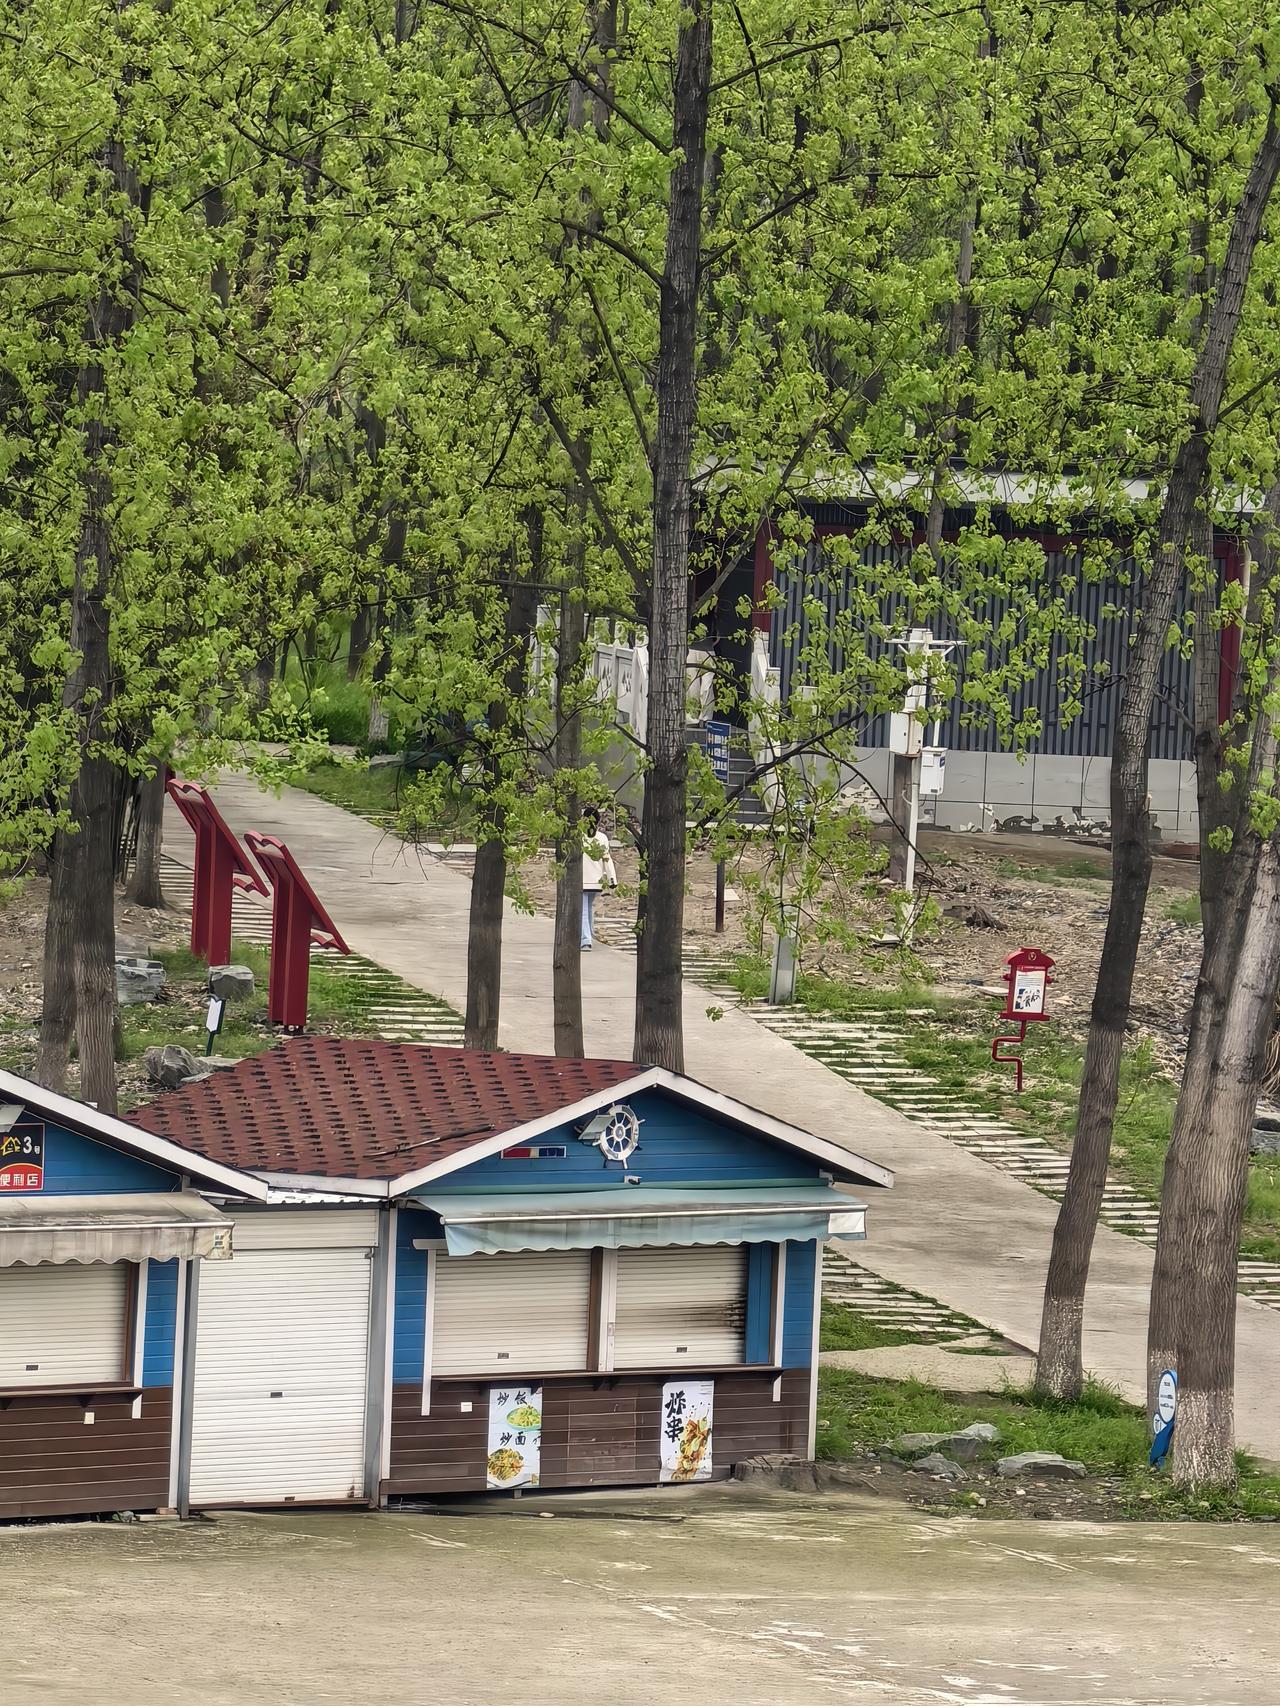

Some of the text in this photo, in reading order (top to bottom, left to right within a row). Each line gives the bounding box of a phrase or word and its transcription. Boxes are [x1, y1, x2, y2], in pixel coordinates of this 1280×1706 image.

[0, 1173, 39, 1187] 便利店
[497, 1390, 528, 1407] 炒饭
[664, 1390, 687, 1443] 炸串
[499, 1431, 527, 1447] 炒面
